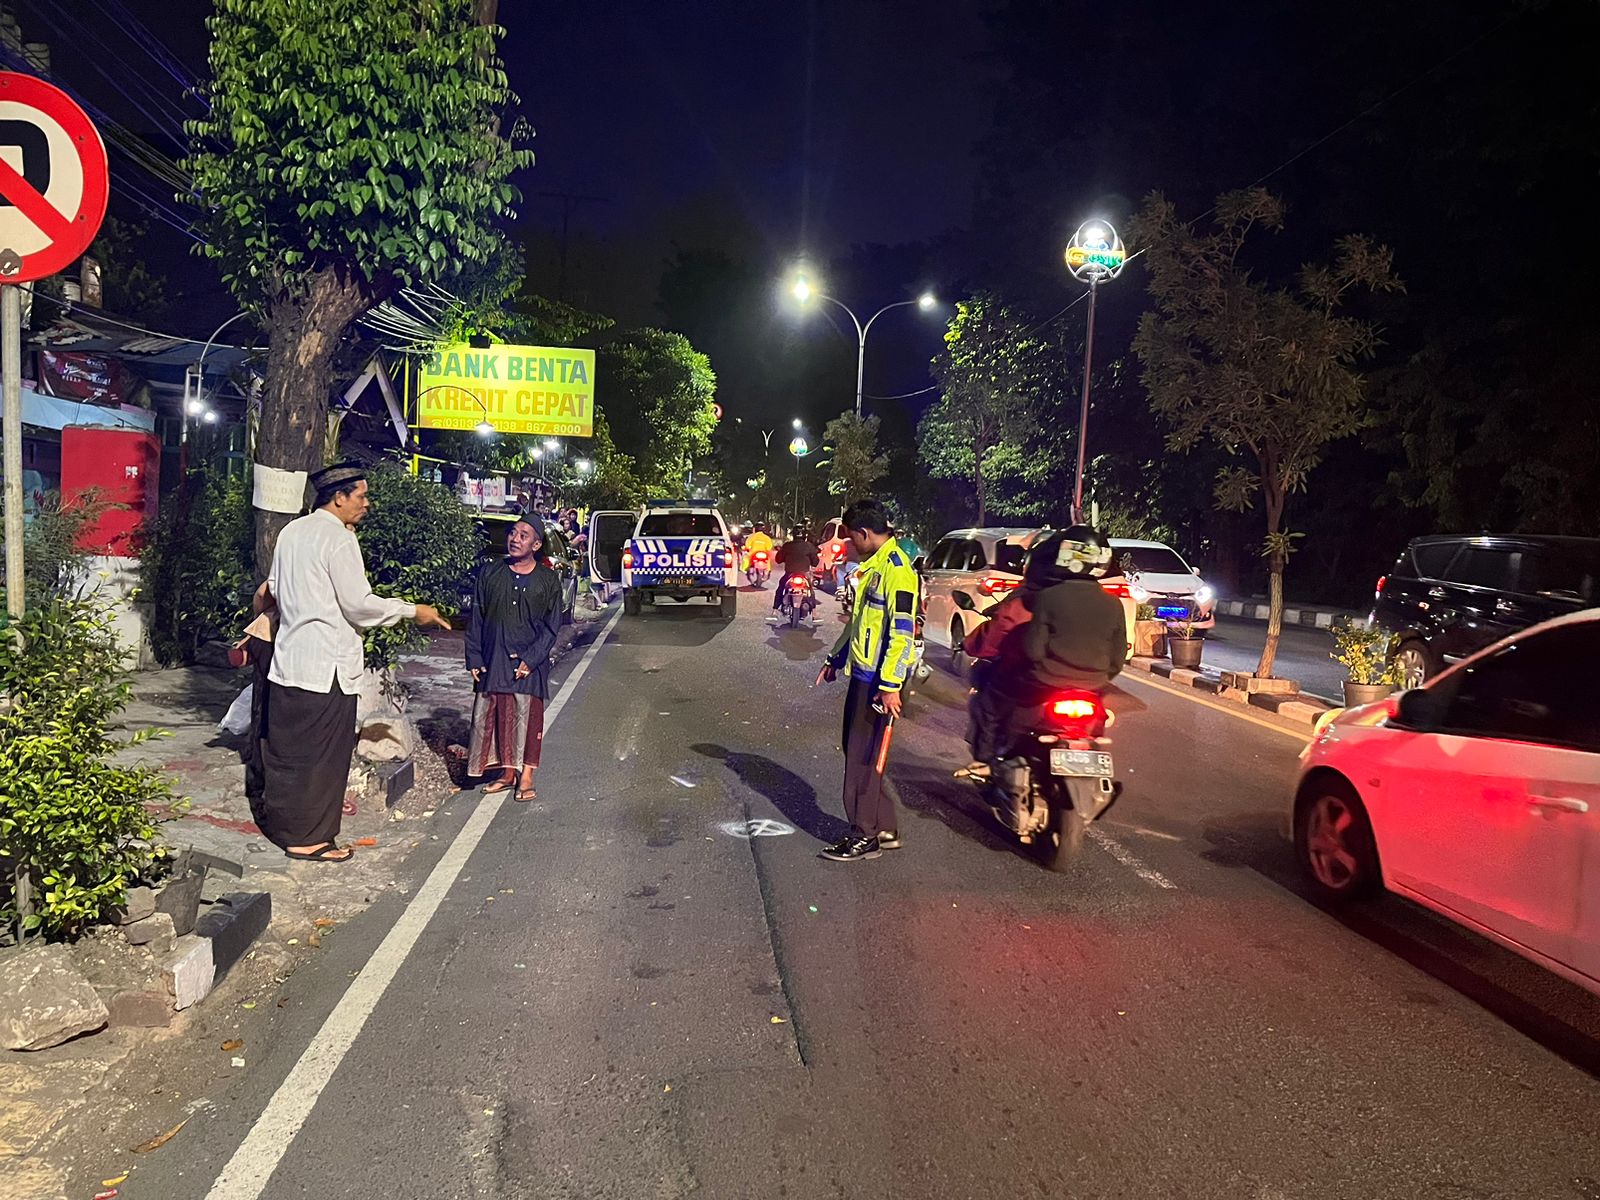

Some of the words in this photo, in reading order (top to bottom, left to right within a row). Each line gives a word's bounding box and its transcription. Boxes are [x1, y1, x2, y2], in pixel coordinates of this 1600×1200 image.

[426, 352, 499, 379] BANK
[508, 356, 588, 384] BENTA
[426, 386, 508, 413] KREDIT
[516, 390, 588, 417] CEPAT
[643, 554, 712, 567] POLISI
